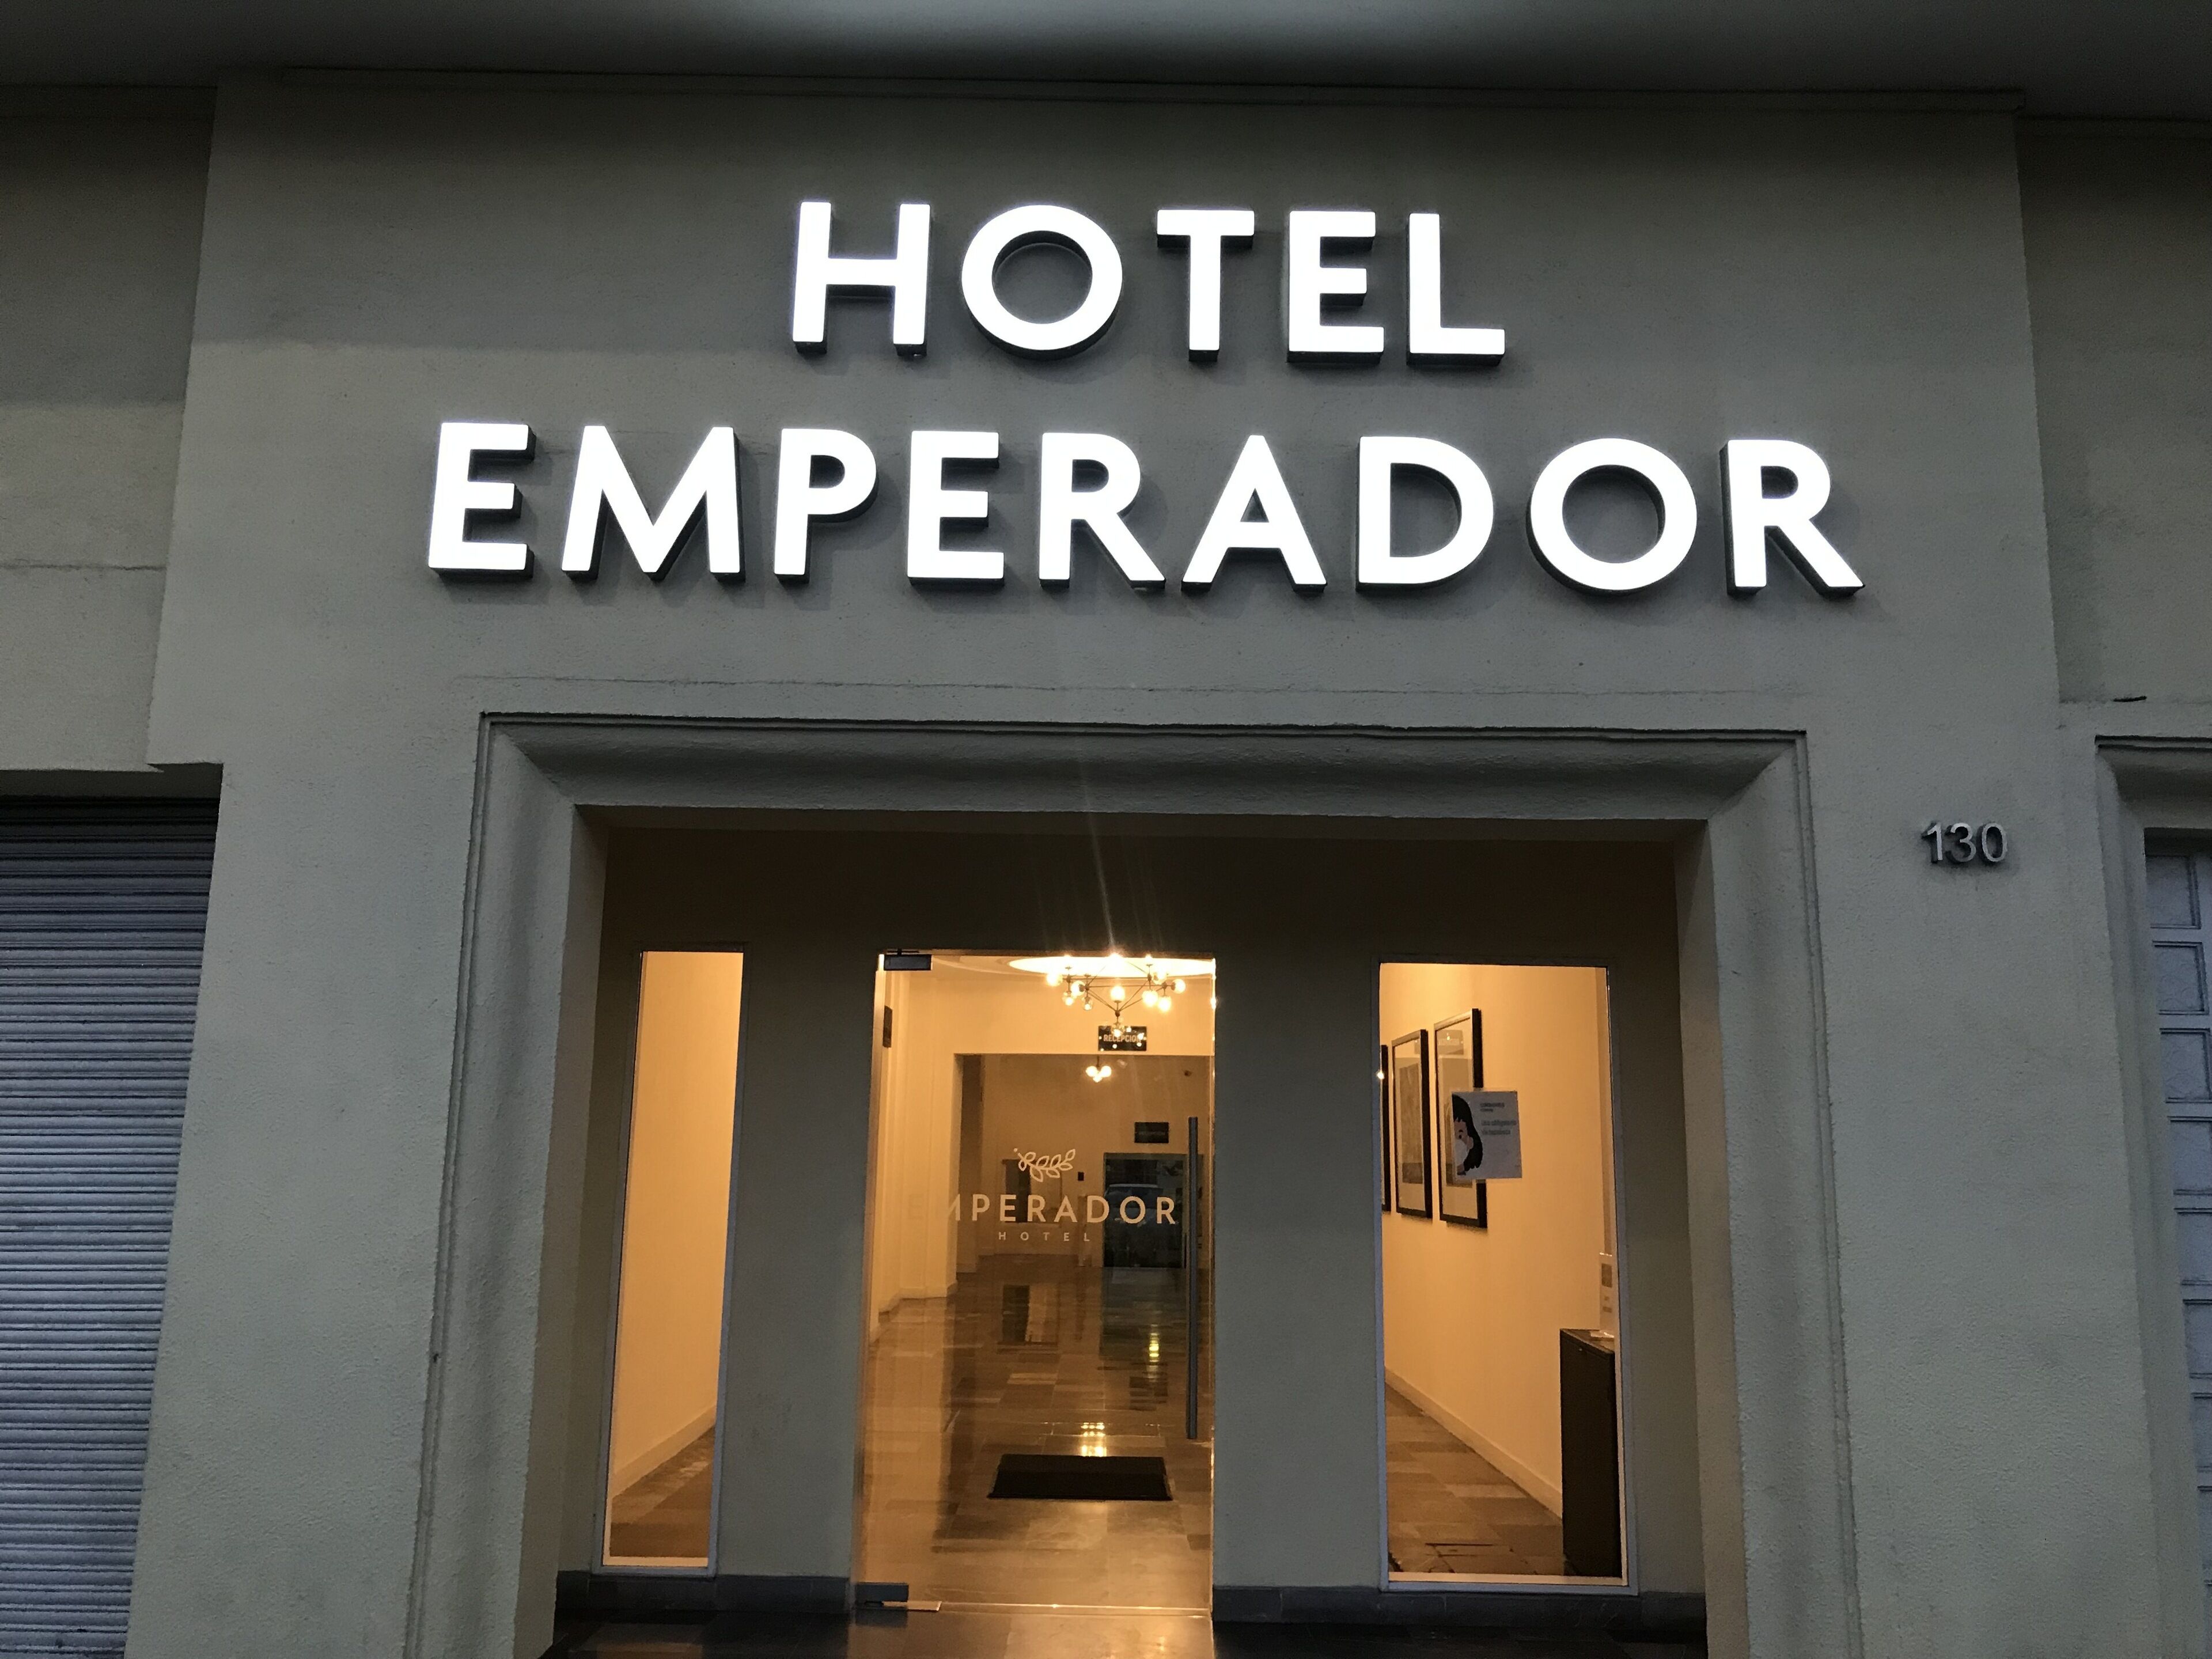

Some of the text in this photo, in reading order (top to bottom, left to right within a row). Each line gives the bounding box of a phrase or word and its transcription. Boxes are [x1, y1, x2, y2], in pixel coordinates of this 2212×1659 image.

[792, 201, 1508, 356] HOTEL
[427, 422, 1864, 591] EMPERADOR
[1924, 822, 2008, 863] 130
[998, 1232, 1090, 1241] HOTEL
